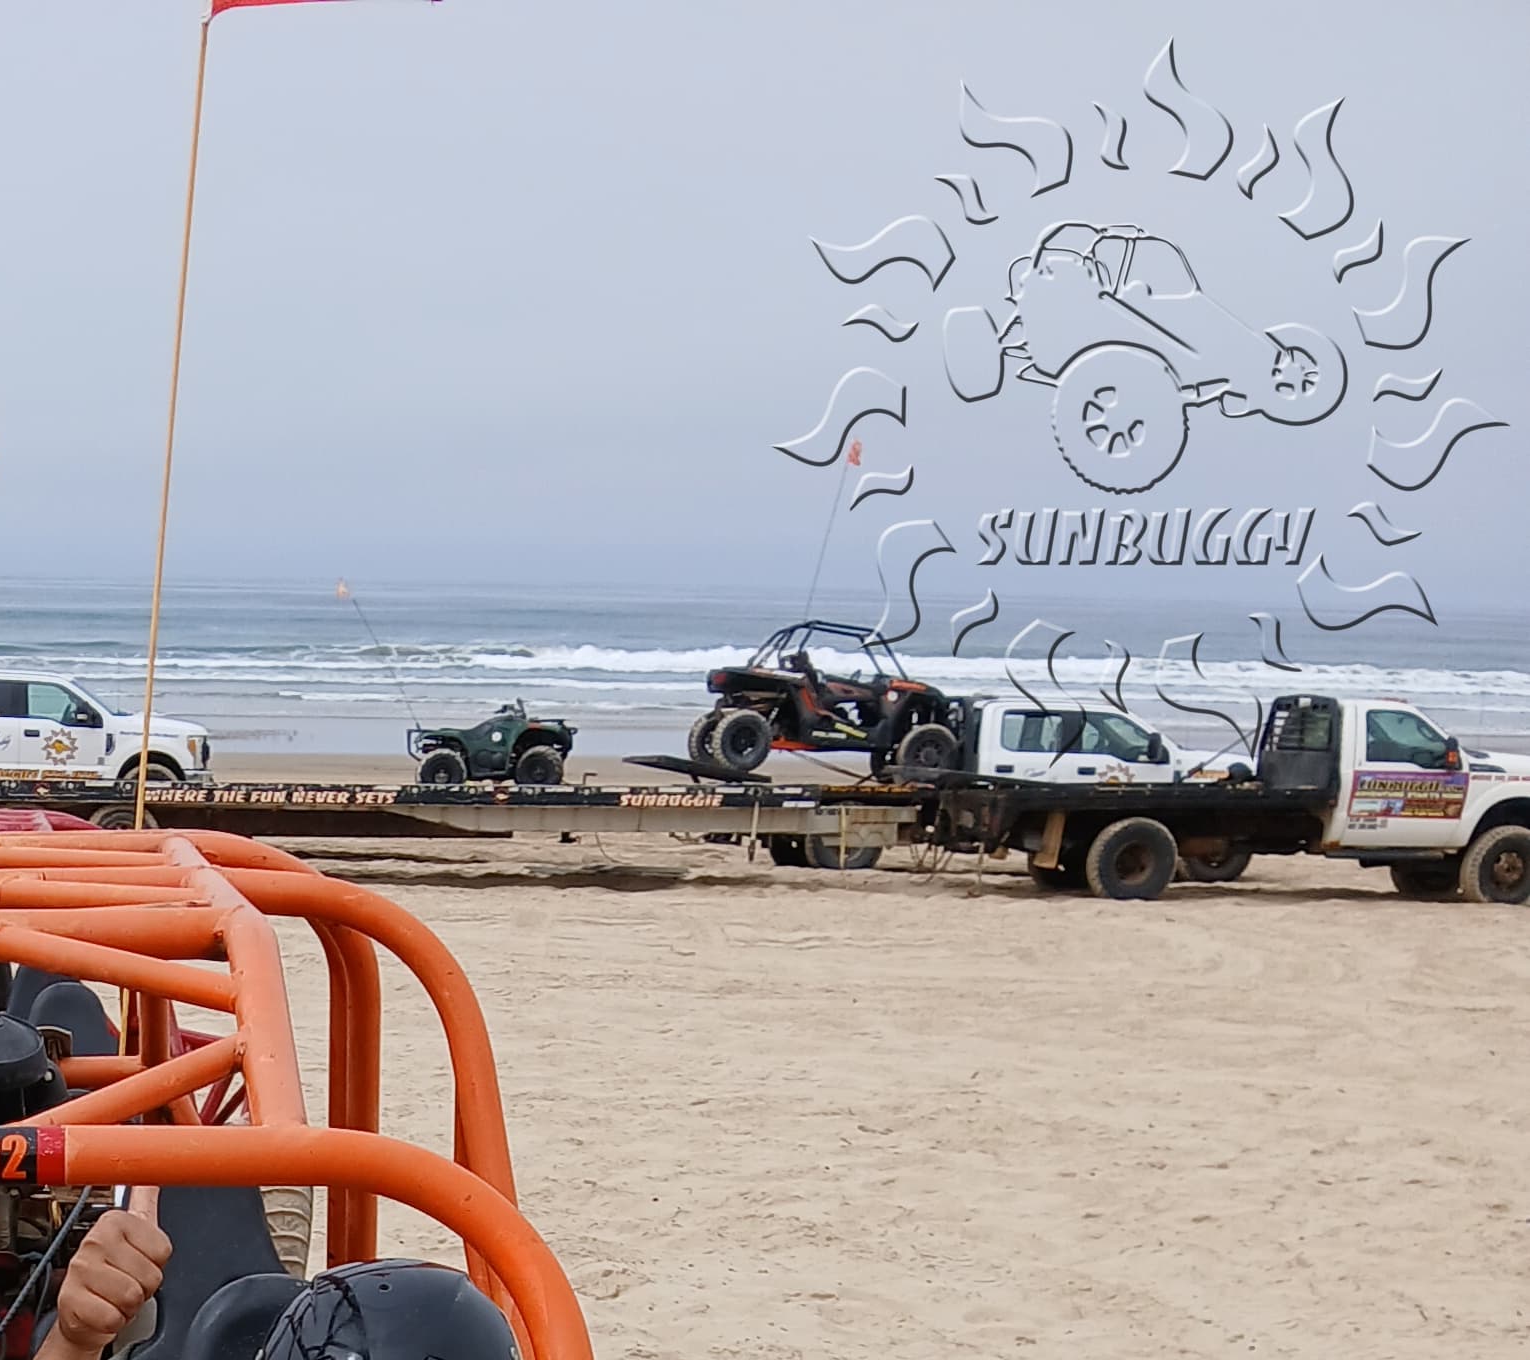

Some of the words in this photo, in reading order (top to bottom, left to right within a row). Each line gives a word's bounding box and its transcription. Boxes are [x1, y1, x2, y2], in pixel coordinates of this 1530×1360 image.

[144, 789, 208, 803] WHERE
[213, 790, 247, 803] THE
[250, 790, 287, 803] FUN
[291, 790, 351, 804] NEVER
[355, 791, 398, 804] SETS
[620, 794, 724, 807] SUNBUGGIE
